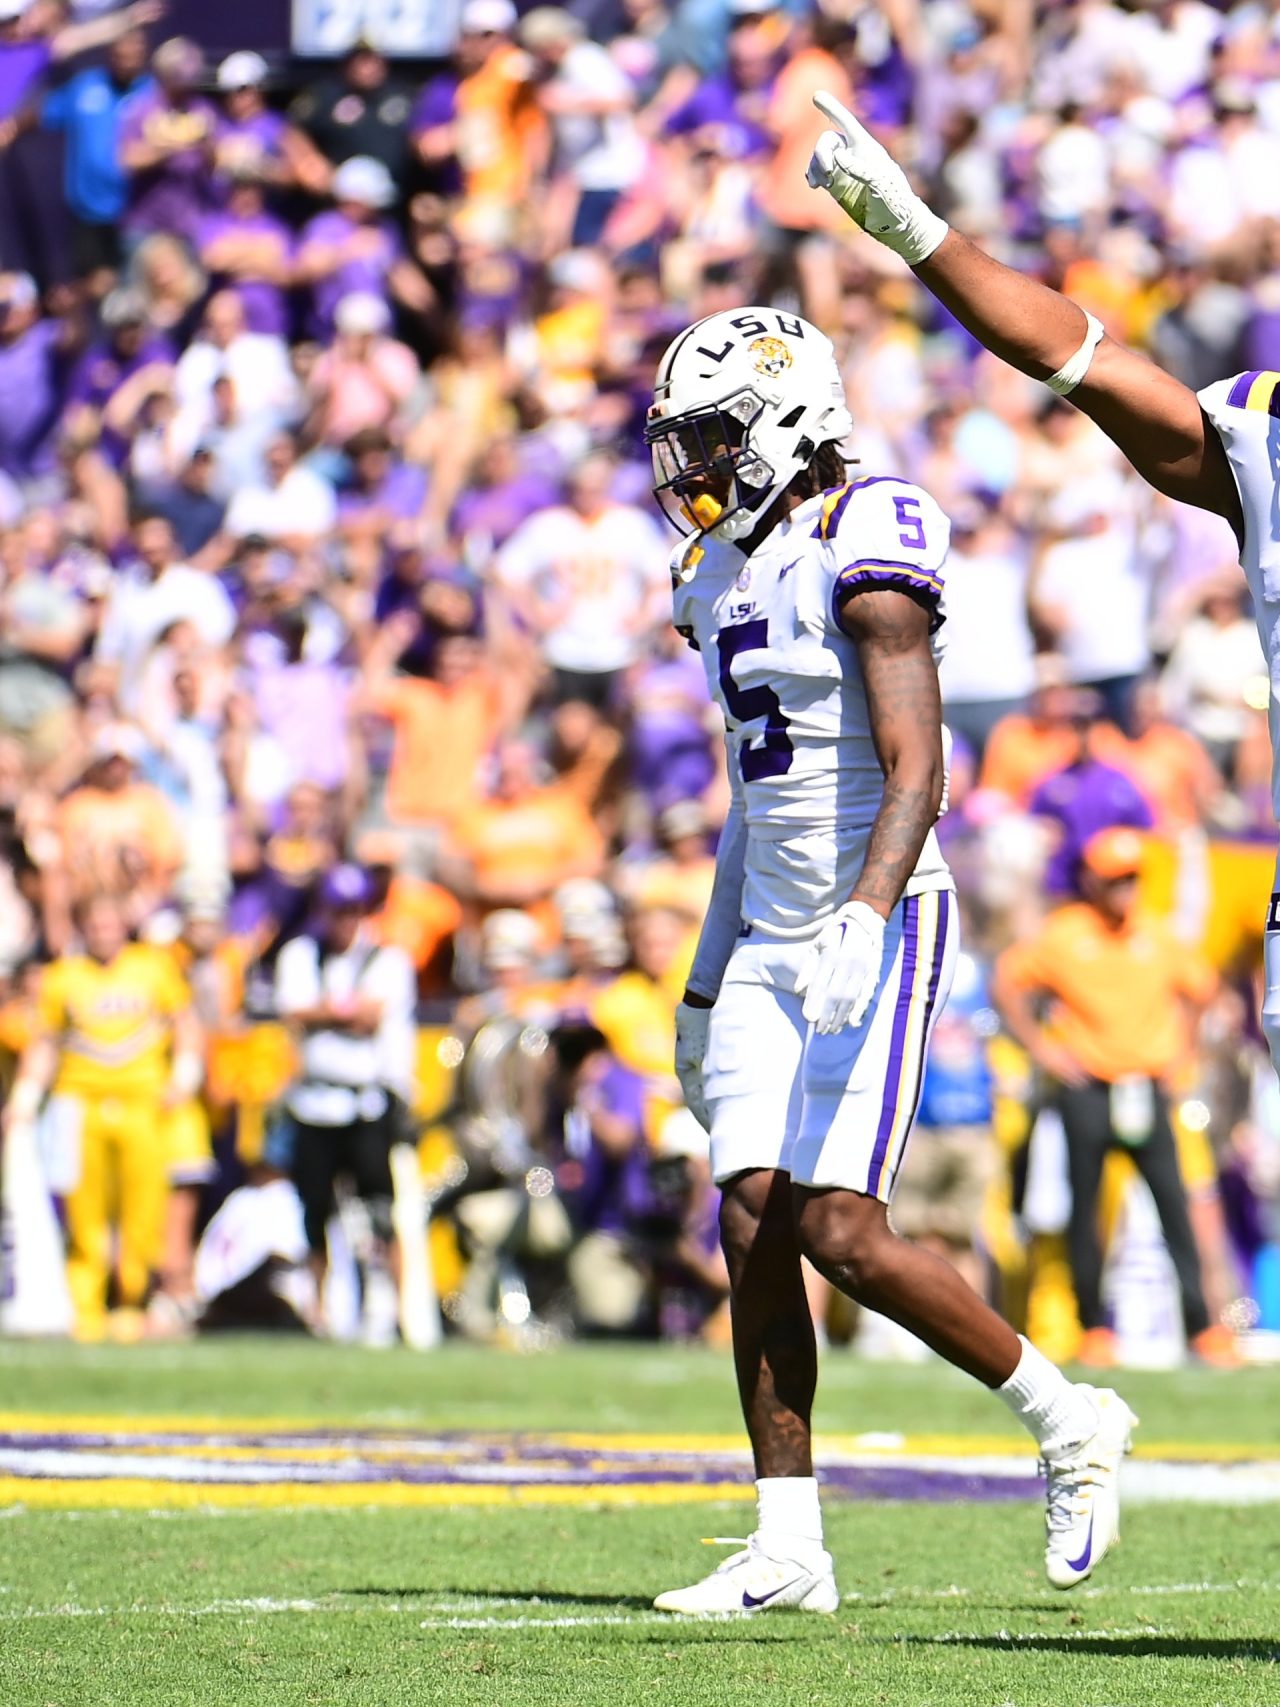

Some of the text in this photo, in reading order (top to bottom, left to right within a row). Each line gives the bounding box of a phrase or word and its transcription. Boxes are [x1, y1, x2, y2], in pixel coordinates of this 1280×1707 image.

[696, 315, 804, 363] LSU
[892, 496, 926, 549] 5
[730, 601, 756, 619] LSU
[717, 618, 793, 782] 5
